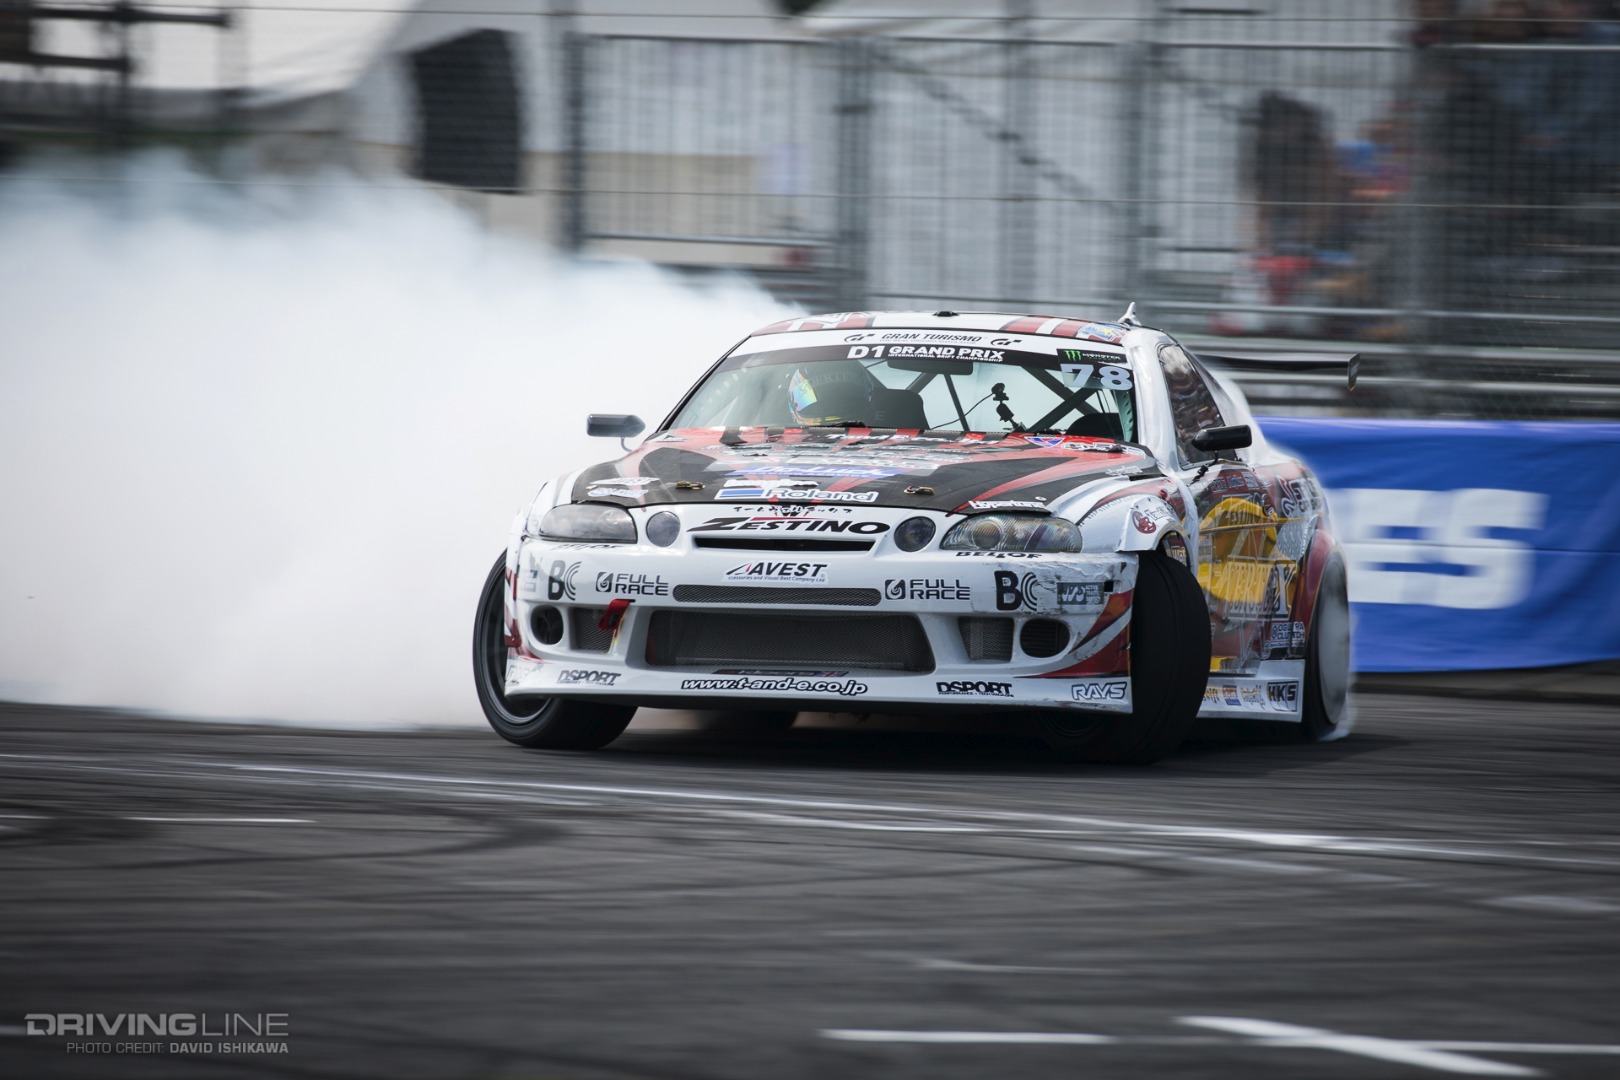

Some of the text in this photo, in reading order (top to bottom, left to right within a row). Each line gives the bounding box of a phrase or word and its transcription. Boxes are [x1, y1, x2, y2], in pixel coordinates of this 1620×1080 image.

[923, 334, 983, 342] TURISMO
[847, 345, 885, 359] D1
[889, 345, 1006, 360] GRAND PRIX
[1060, 363, 1133, 390] 78
[764, 489, 876, 502] Roland
[686, 517, 891, 534] ZESTINO
[747, 562, 828, 577] AVEST
[616, 573, 669, 585] FULL
[909, 578, 970, 589] FULL
[615, 584, 669, 596] RACE
[909, 589, 970, 600] RACE
[557, 670, 622, 684] DSPORT
[681, 678, 868, 696] www.t-and-e.co.jp
[936, 681, 1013, 694] DSPORT
[1071, 682, 1128, 701] RAYS
[1267, 682, 1298, 704] HKS
